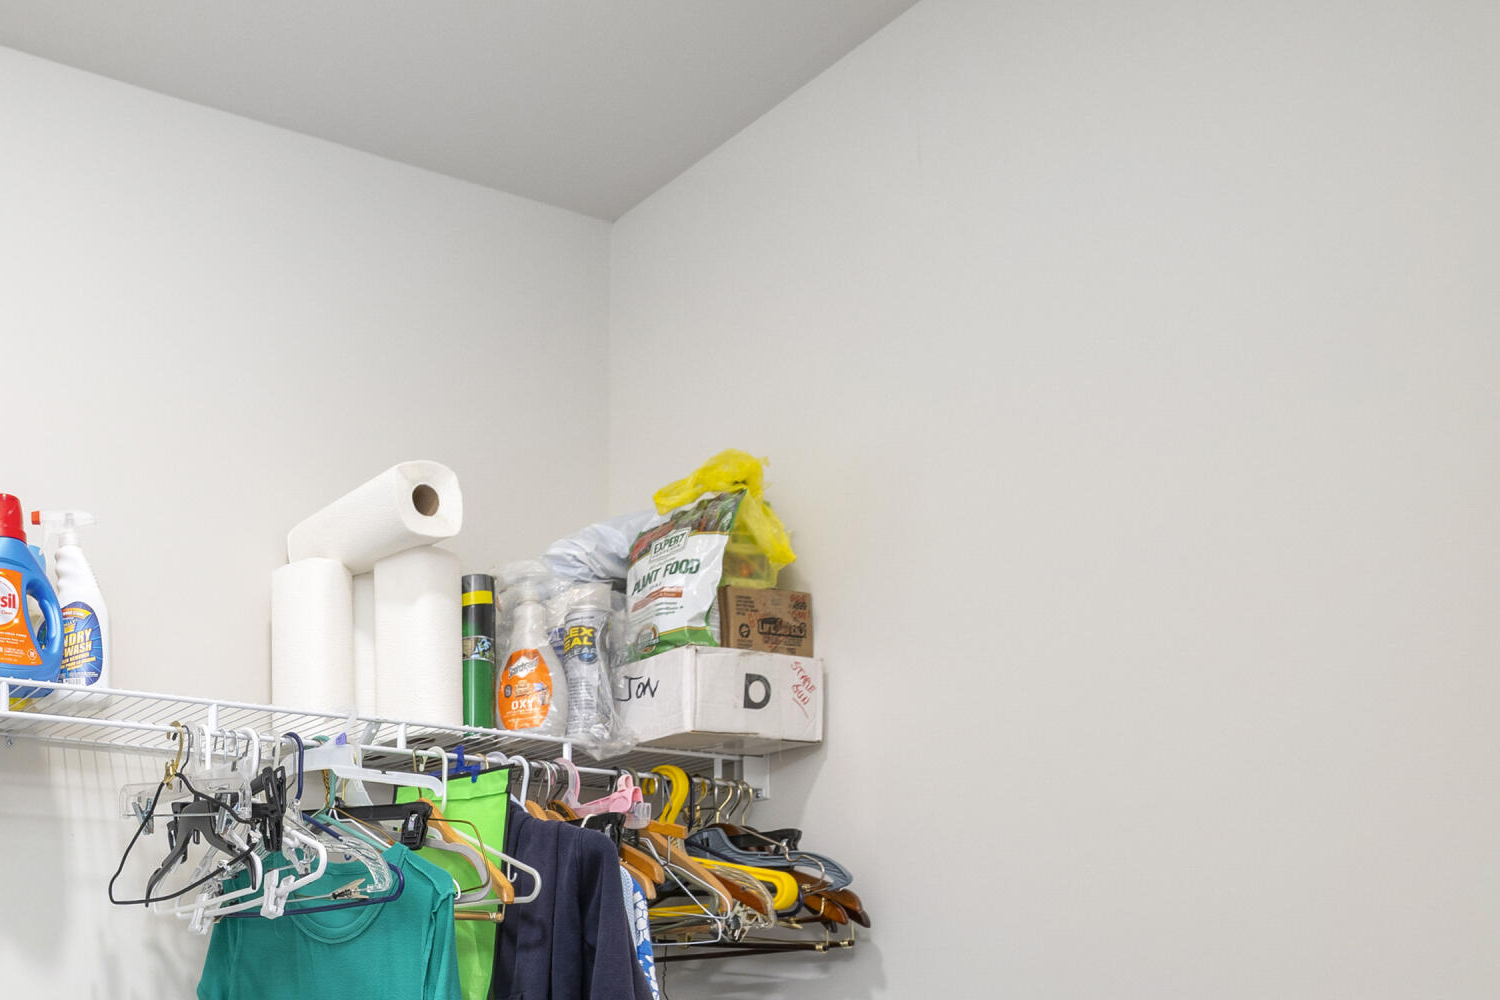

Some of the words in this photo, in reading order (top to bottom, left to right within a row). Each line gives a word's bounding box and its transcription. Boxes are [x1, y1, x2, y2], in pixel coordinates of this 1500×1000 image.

[653, 532, 686, 554] EXPERT
[632, 567, 662, 597] PLANT
[663, 558, 701, 578] FOOD
[564, 625, 595, 640] LEX
[564, 636, 593, 654] EAL
[743, 672, 772, 710] D
[511, 699, 534, 710] OXY
